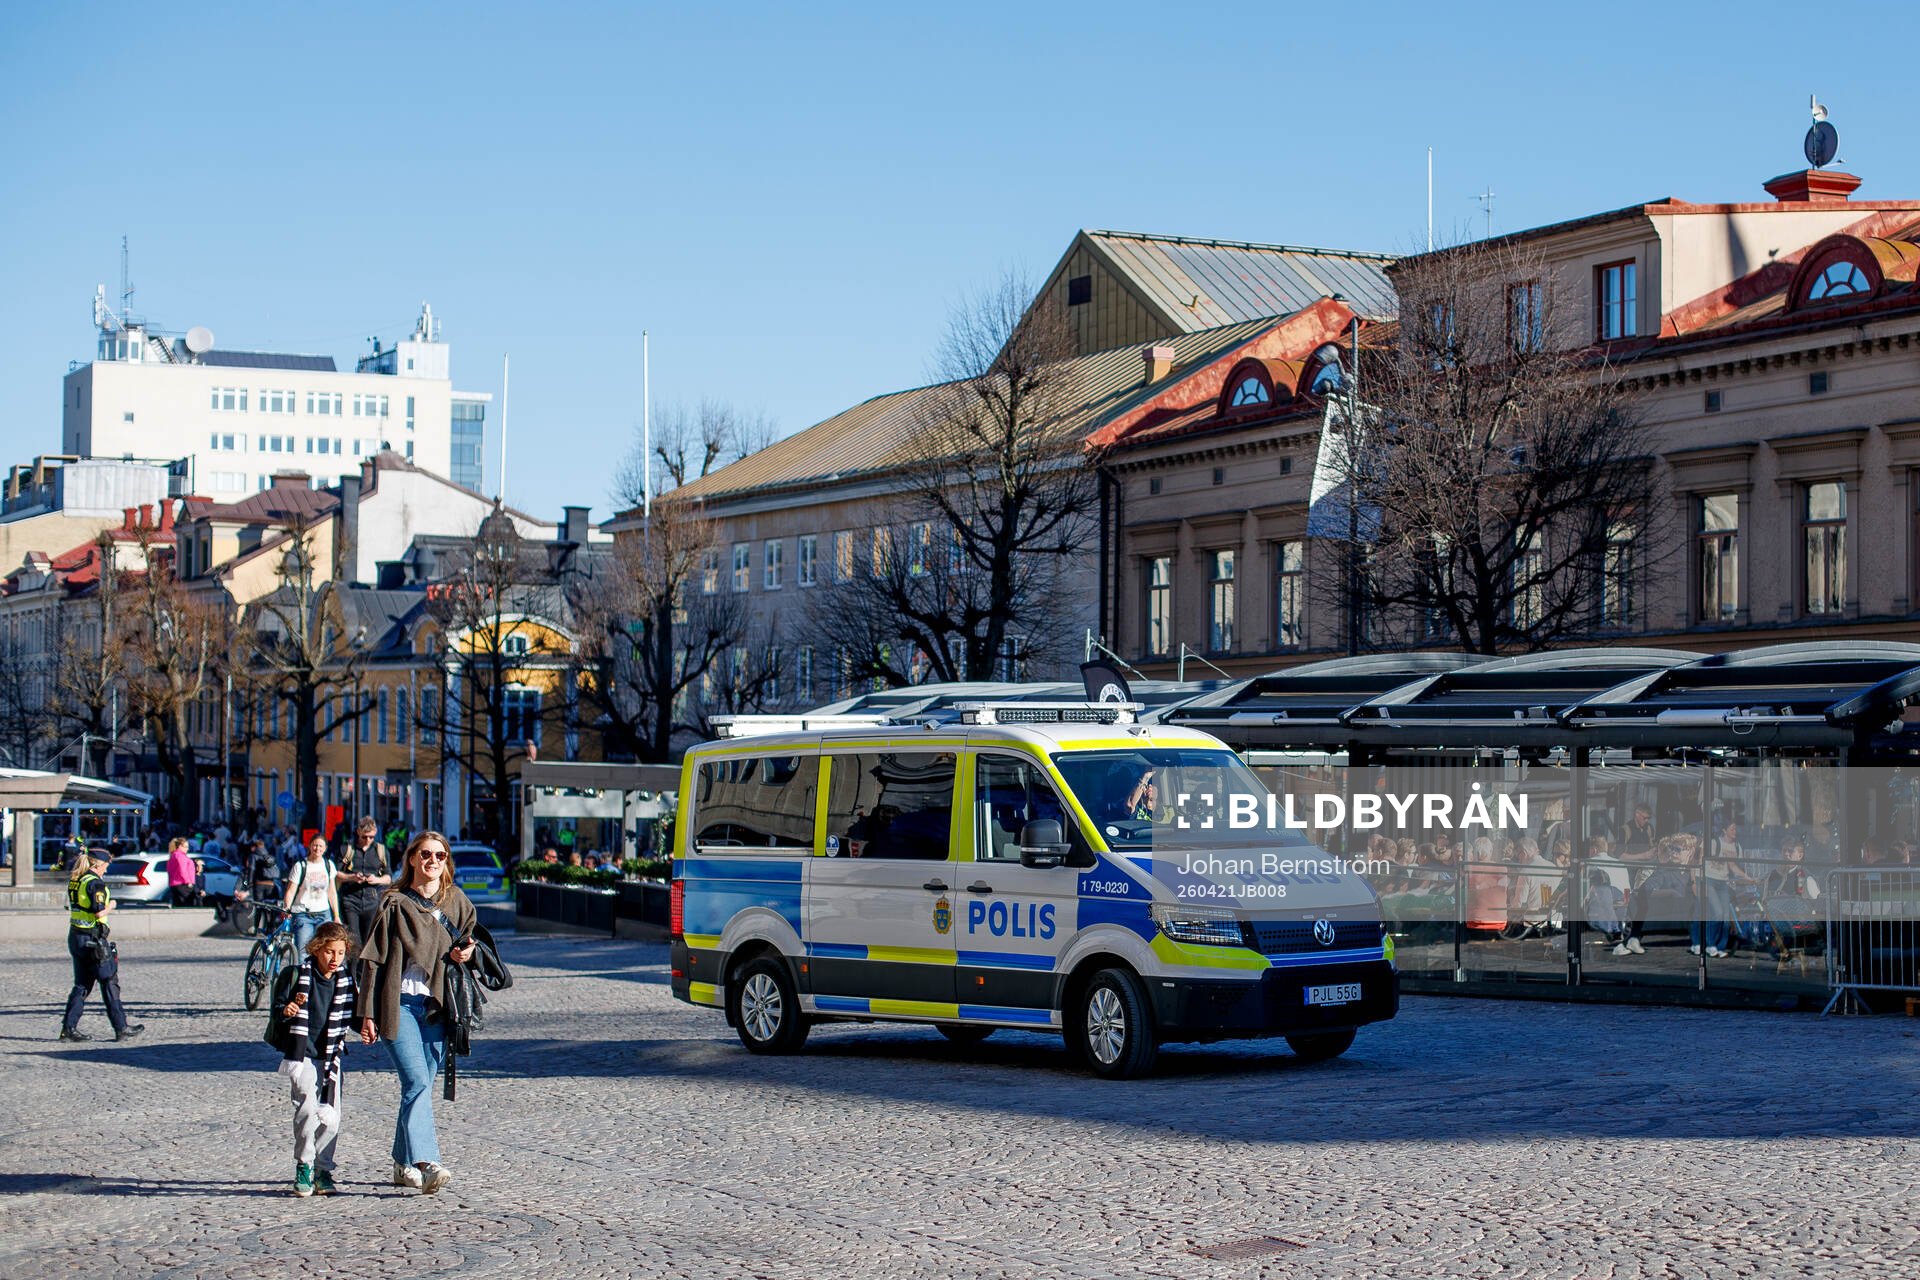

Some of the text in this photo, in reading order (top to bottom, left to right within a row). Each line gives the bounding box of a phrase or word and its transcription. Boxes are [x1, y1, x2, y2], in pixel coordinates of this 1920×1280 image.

[1081, 880, 1129, 895] 1 79-0230
[968, 900, 1057, 940] POLIS
[1313, 985, 1357, 1002] PJL 55G
